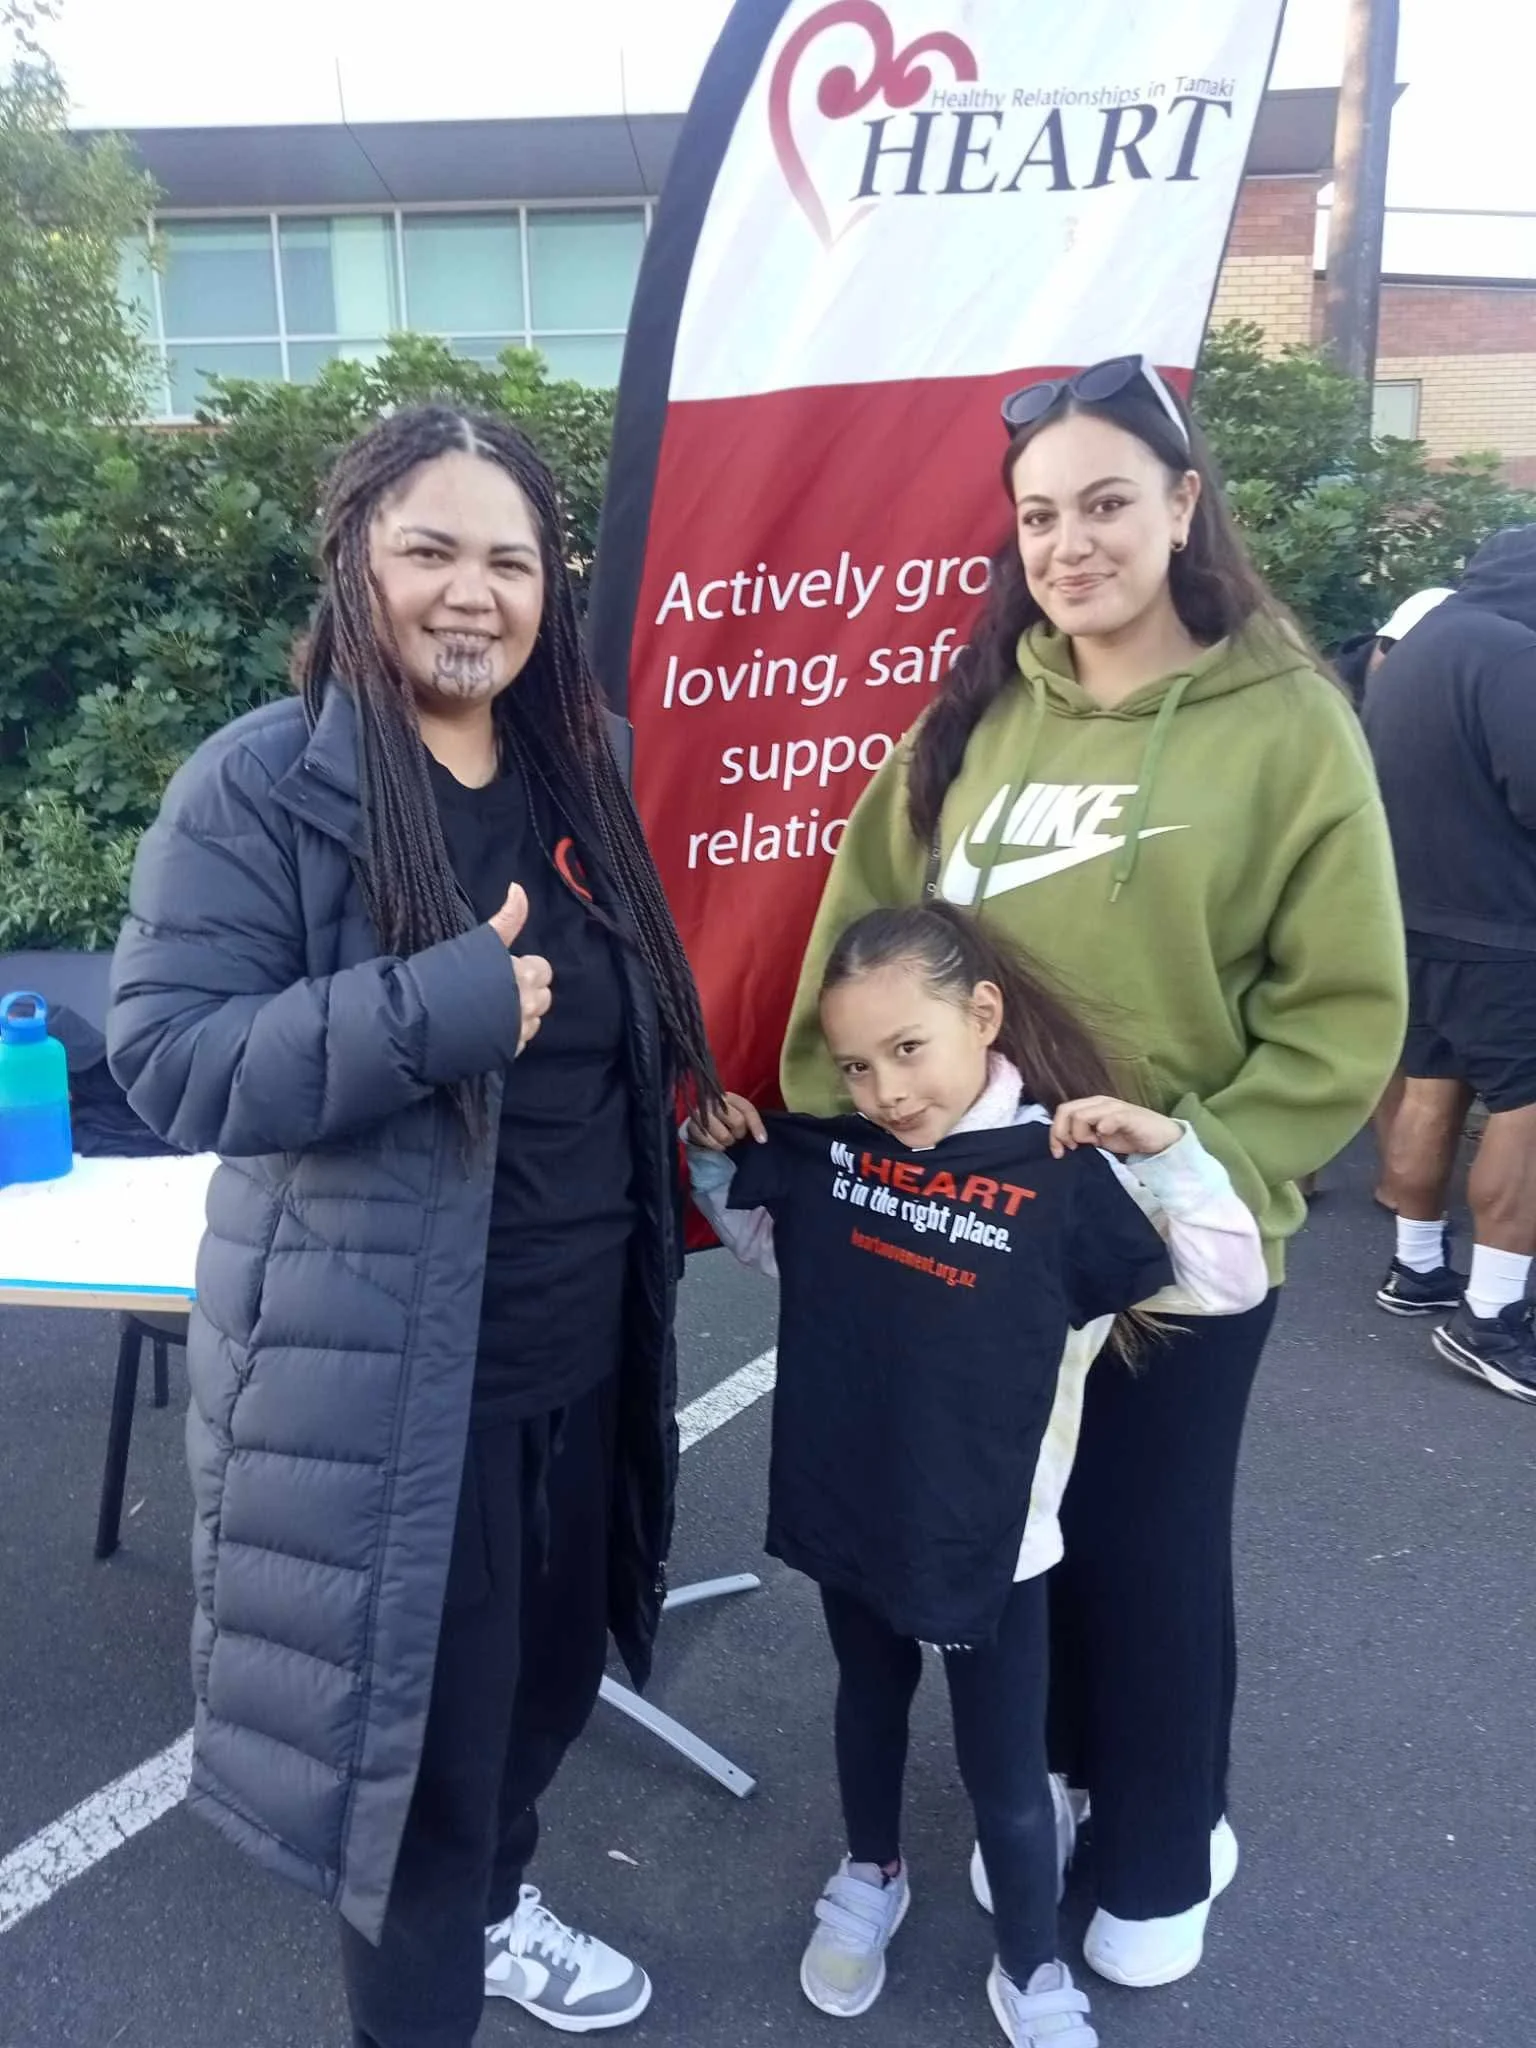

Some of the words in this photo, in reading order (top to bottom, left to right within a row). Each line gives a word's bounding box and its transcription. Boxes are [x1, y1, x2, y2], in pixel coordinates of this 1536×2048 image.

[931, 89, 1004, 109] Healthy
[1011, 85, 1140, 108] Relationships
[1147, 79, 1165, 98] in
[1176, 76, 1235, 98] Tamaki
[848, 95, 1232, 202] HEART
[655, 551, 885, 625] Actively
[895, 555, 992, 614] gro
[663, 648, 848, 709] loving,
[720, 731, 906, 792] suppo
[969, 783, 1139, 848] NIKE
[830, 1140, 855, 1174] My
[860, 1151, 1037, 1217] HEART
[832, 1171, 850, 1200] is
[850, 1177, 866, 1207] in
[869, 1185, 897, 1217] the
[901, 1199, 950, 1233] right
[950, 1211, 1012, 1252] place.
